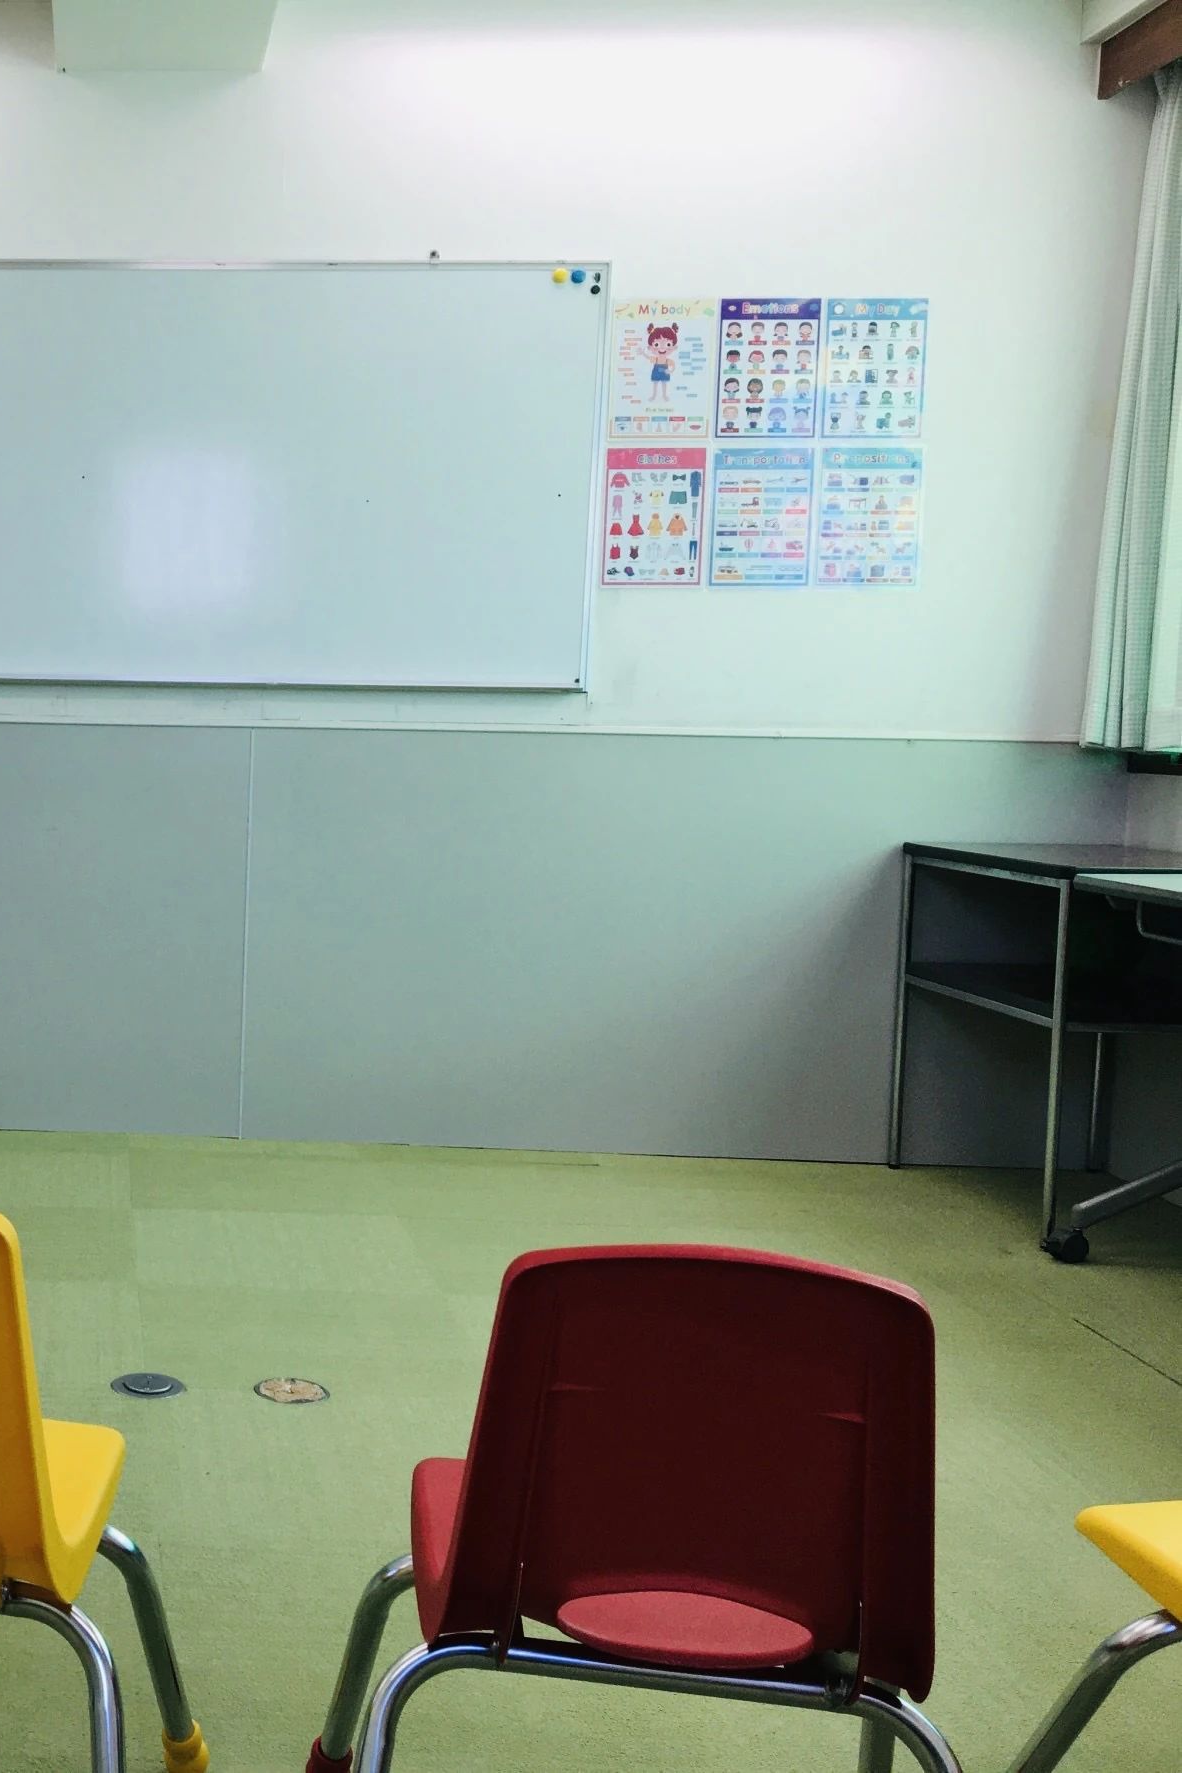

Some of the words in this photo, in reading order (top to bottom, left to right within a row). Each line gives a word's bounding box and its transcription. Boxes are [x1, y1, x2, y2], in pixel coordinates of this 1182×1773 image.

[638, 304, 657, 315] My
[661, 304, 691, 316] body
[741, 301, 799, 314] Emotions
[855, 302, 876, 316] My
[877, 302, 900, 316] Day
[636, 453, 678, 465] Clothes
[723, 454, 806, 466] Transportation
[833, 453, 910, 465] Prepositions
